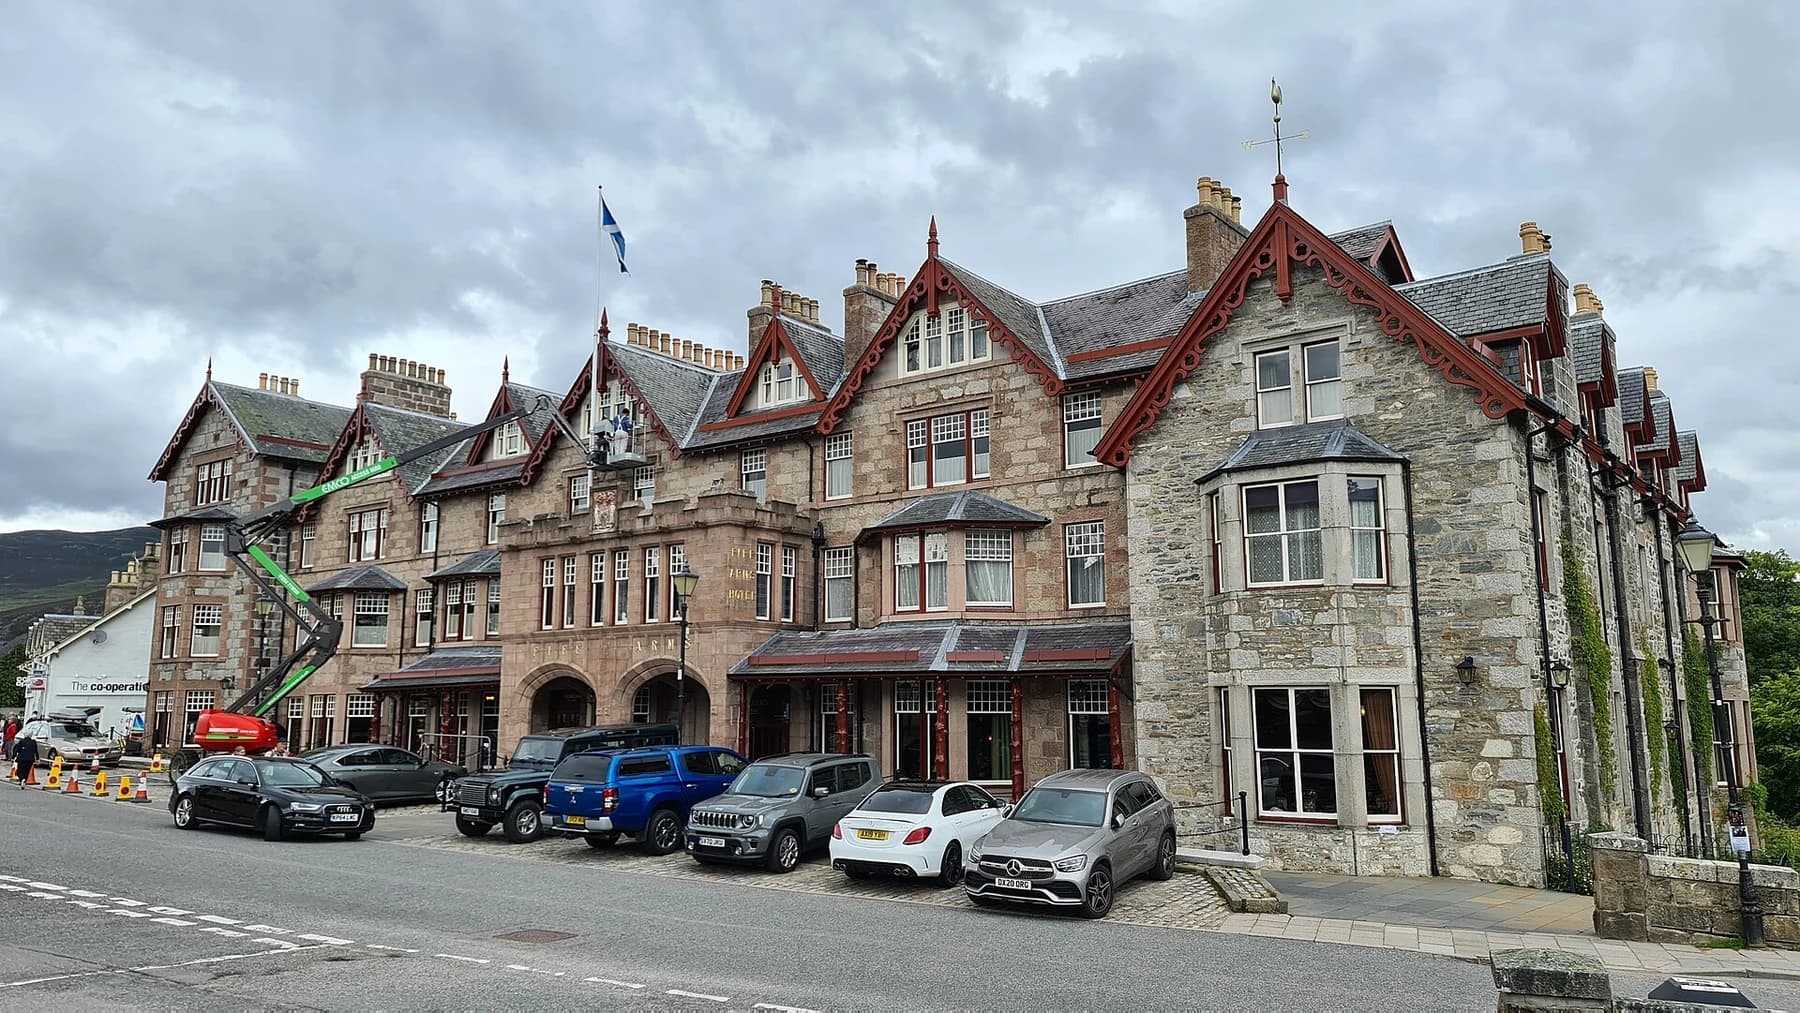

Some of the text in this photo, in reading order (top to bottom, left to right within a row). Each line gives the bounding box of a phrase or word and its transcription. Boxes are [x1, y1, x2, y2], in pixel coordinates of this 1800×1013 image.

[321, 477, 350, 492] EMCO
[728, 589, 755, 601] HOTEL
[533, 639, 692, 657] FIFE ARMS
[72, 681, 88, 691] The
[997, 879, 1015, 888] DX20
